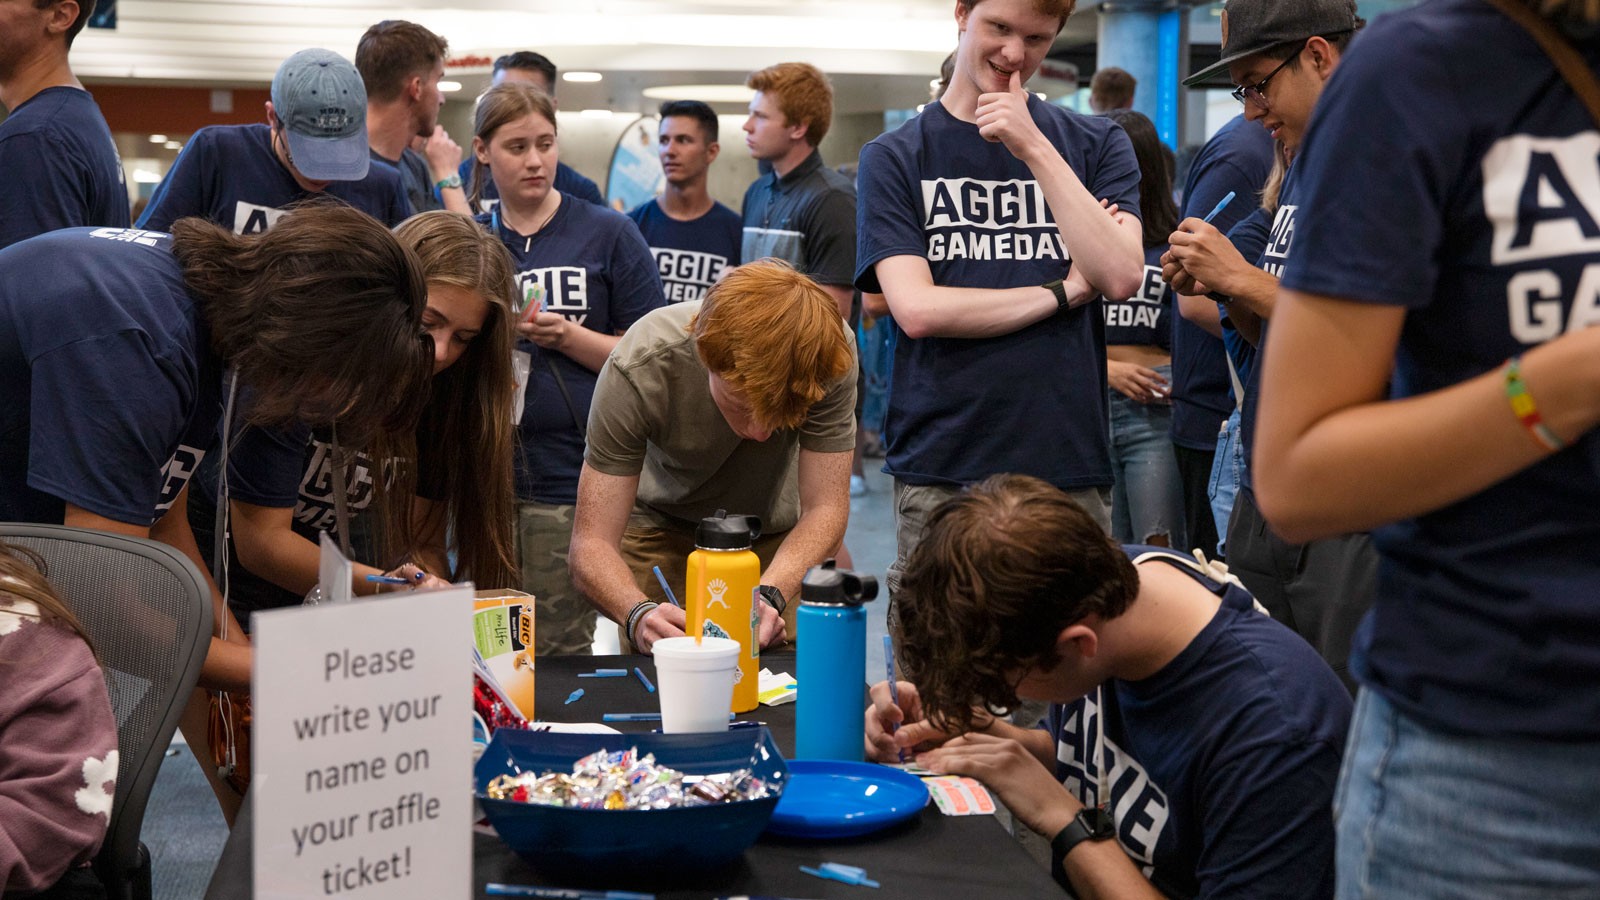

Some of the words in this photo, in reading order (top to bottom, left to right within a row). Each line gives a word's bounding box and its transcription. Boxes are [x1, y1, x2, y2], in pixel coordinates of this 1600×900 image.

[521, 615, 531, 644] BIC
[324, 647, 415, 682] Please
[293, 703, 370, 741] write
[378, 693, 443, 733] your
[305, 756, 387, 793] name
[394, 747, 430, 775] on
[291, 811, 359, 856] your
[367, 792, 441, 833] raffle
[322, 845, 411, 895] ticket!
